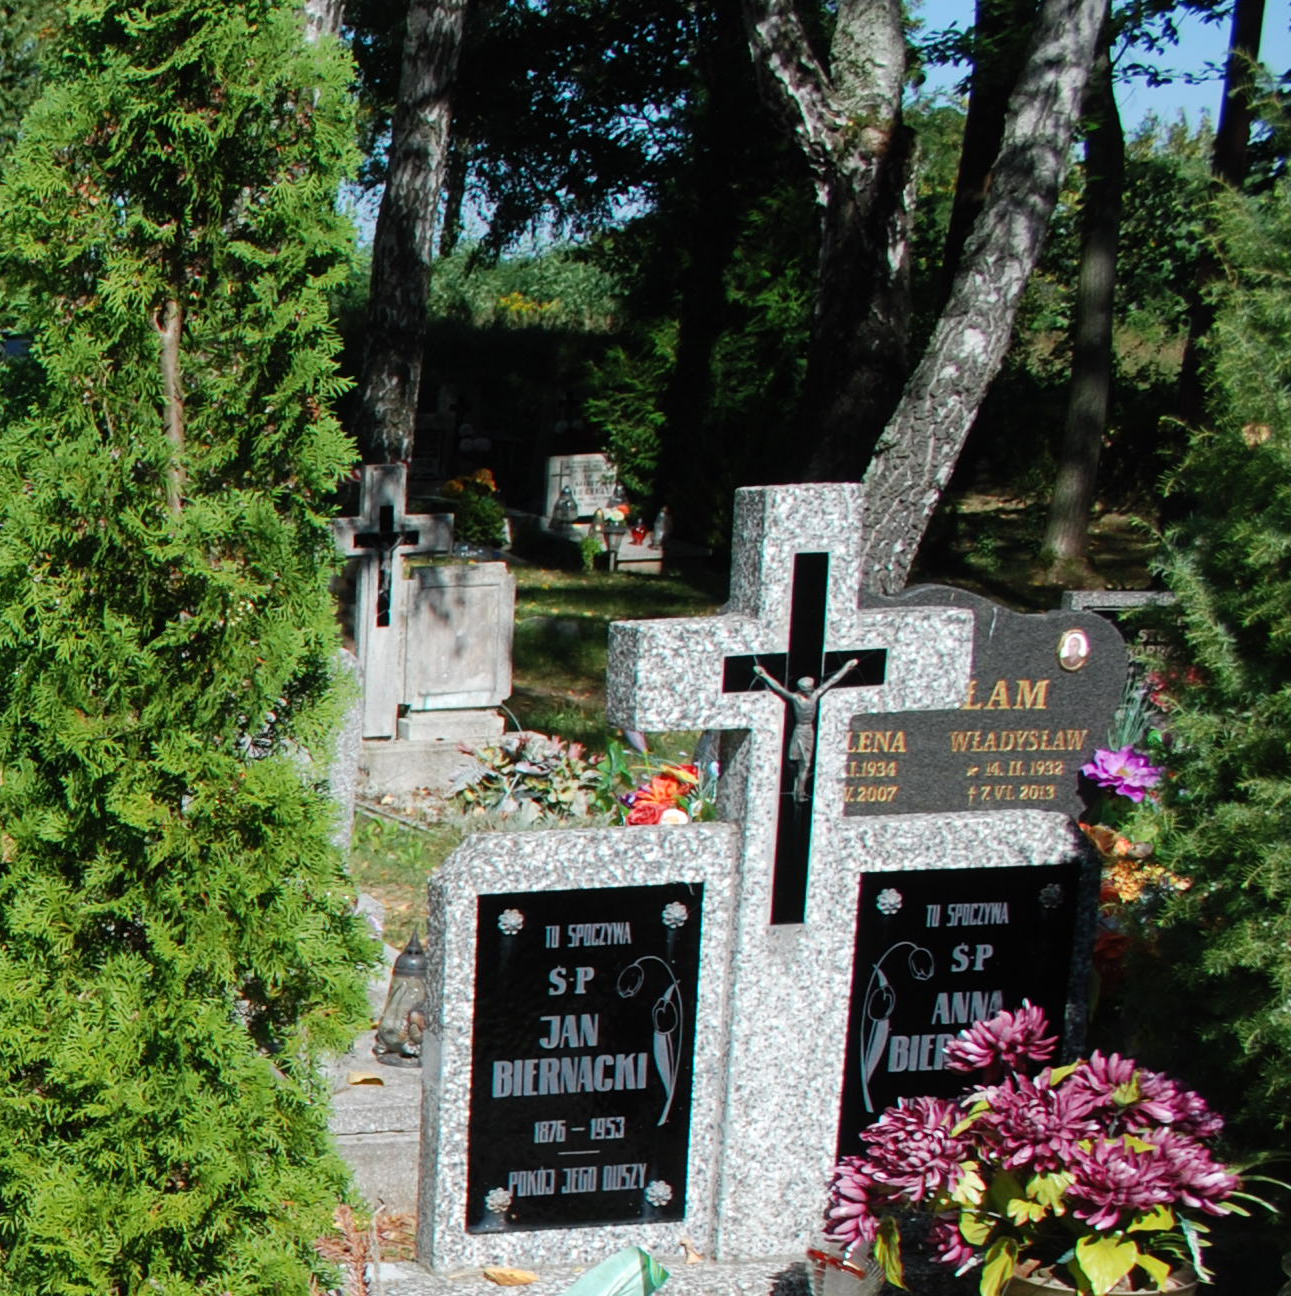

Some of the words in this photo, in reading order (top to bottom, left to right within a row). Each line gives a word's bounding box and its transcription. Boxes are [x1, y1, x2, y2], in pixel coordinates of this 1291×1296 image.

[846, 730, 907, 753] LENA
[950, 729, 1088, 752] WŁADYSŁAW
[926, 904, 941, 927] TU
[947, 902, 1009, 927] SPOCZYWA
[545, 925, 560, 948] TU
[568, 922, 631, 947] SPOCZYWA
[539, 1014, 599, 1049] JAN
[492, 1052, 648, 1099] BIERNACKI
[534, 1120, 566, 1143] 1876
[590, 1116, 625, 1140] 1953
[561, 1166, 597, 1194] JEGO
[602, 1163, 647, 1191] DUSZY
